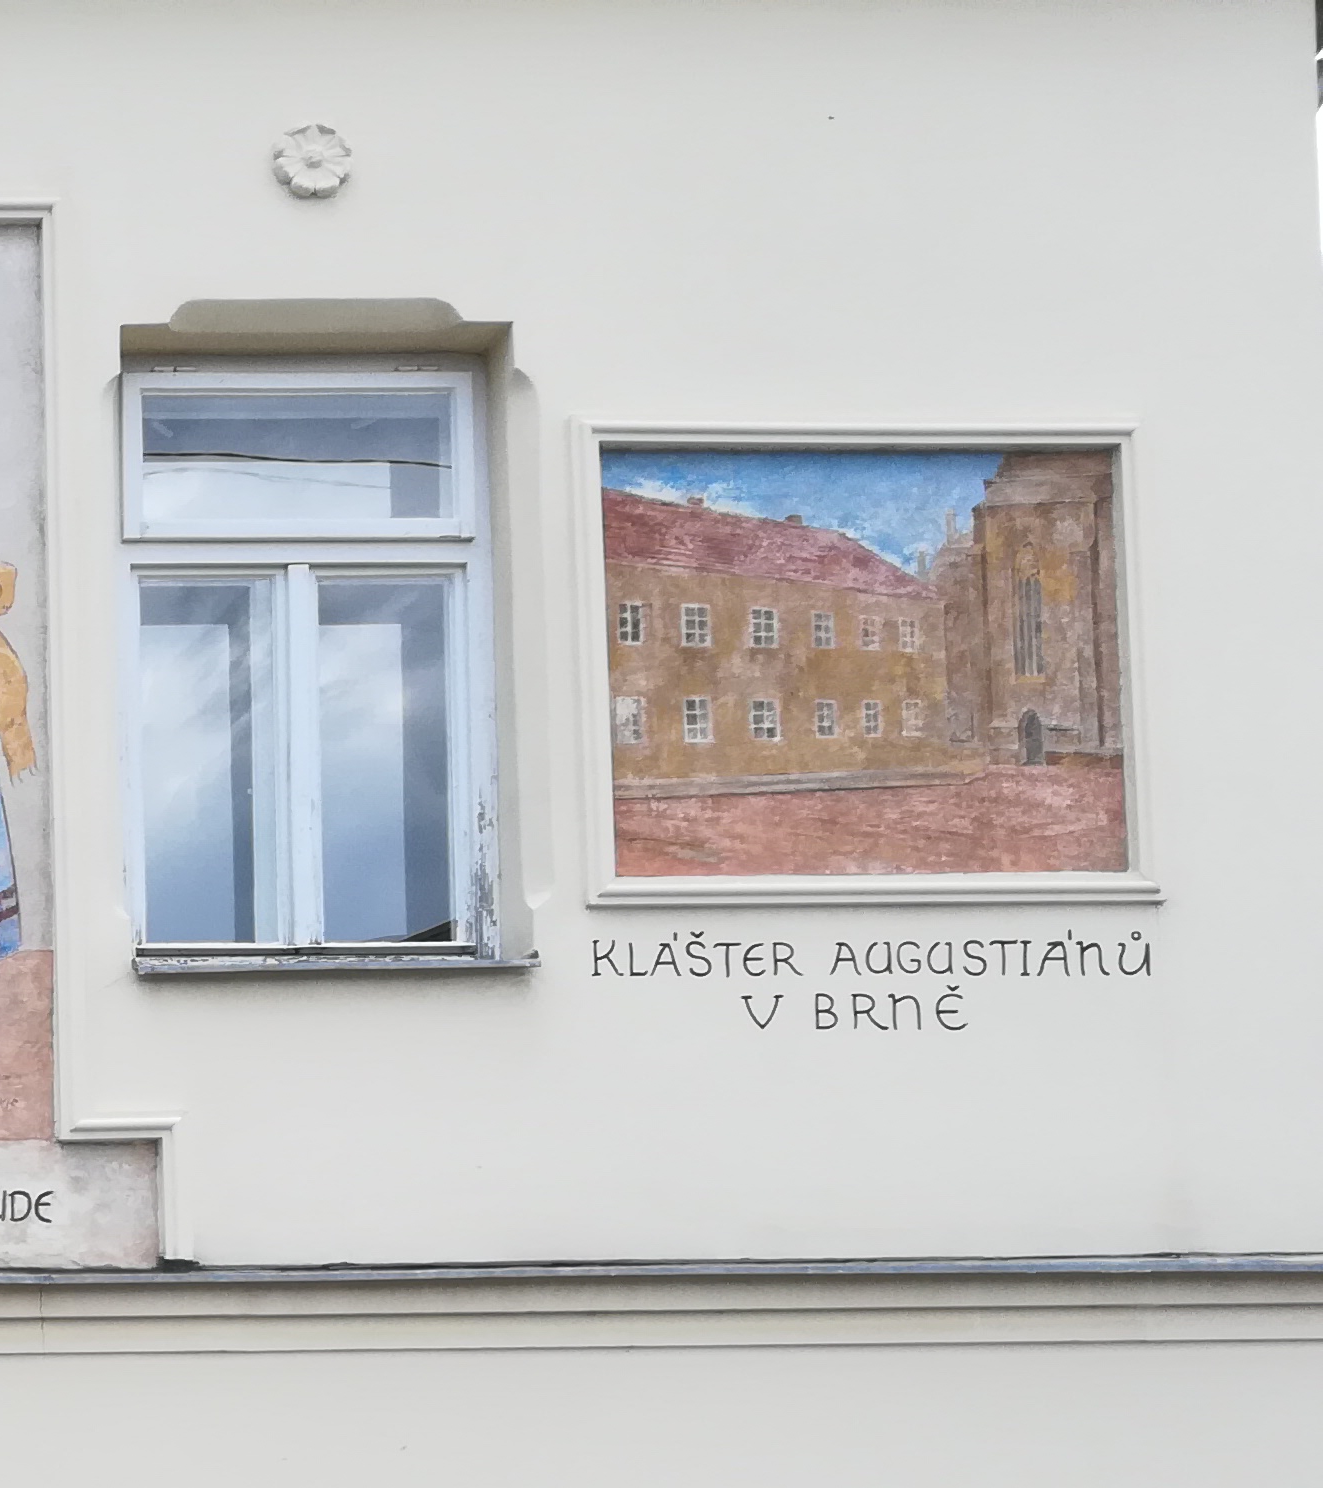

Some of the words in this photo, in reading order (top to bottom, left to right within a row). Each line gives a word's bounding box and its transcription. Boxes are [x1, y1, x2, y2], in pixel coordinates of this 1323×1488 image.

[591, 931, 804, 979] KLÁŠTER
[829, 929, 1153, 978] AUGUSTIÁNŮ
[740, 993, 784, 1029] V
[814, 984, 969, 1031] BRNĚ
